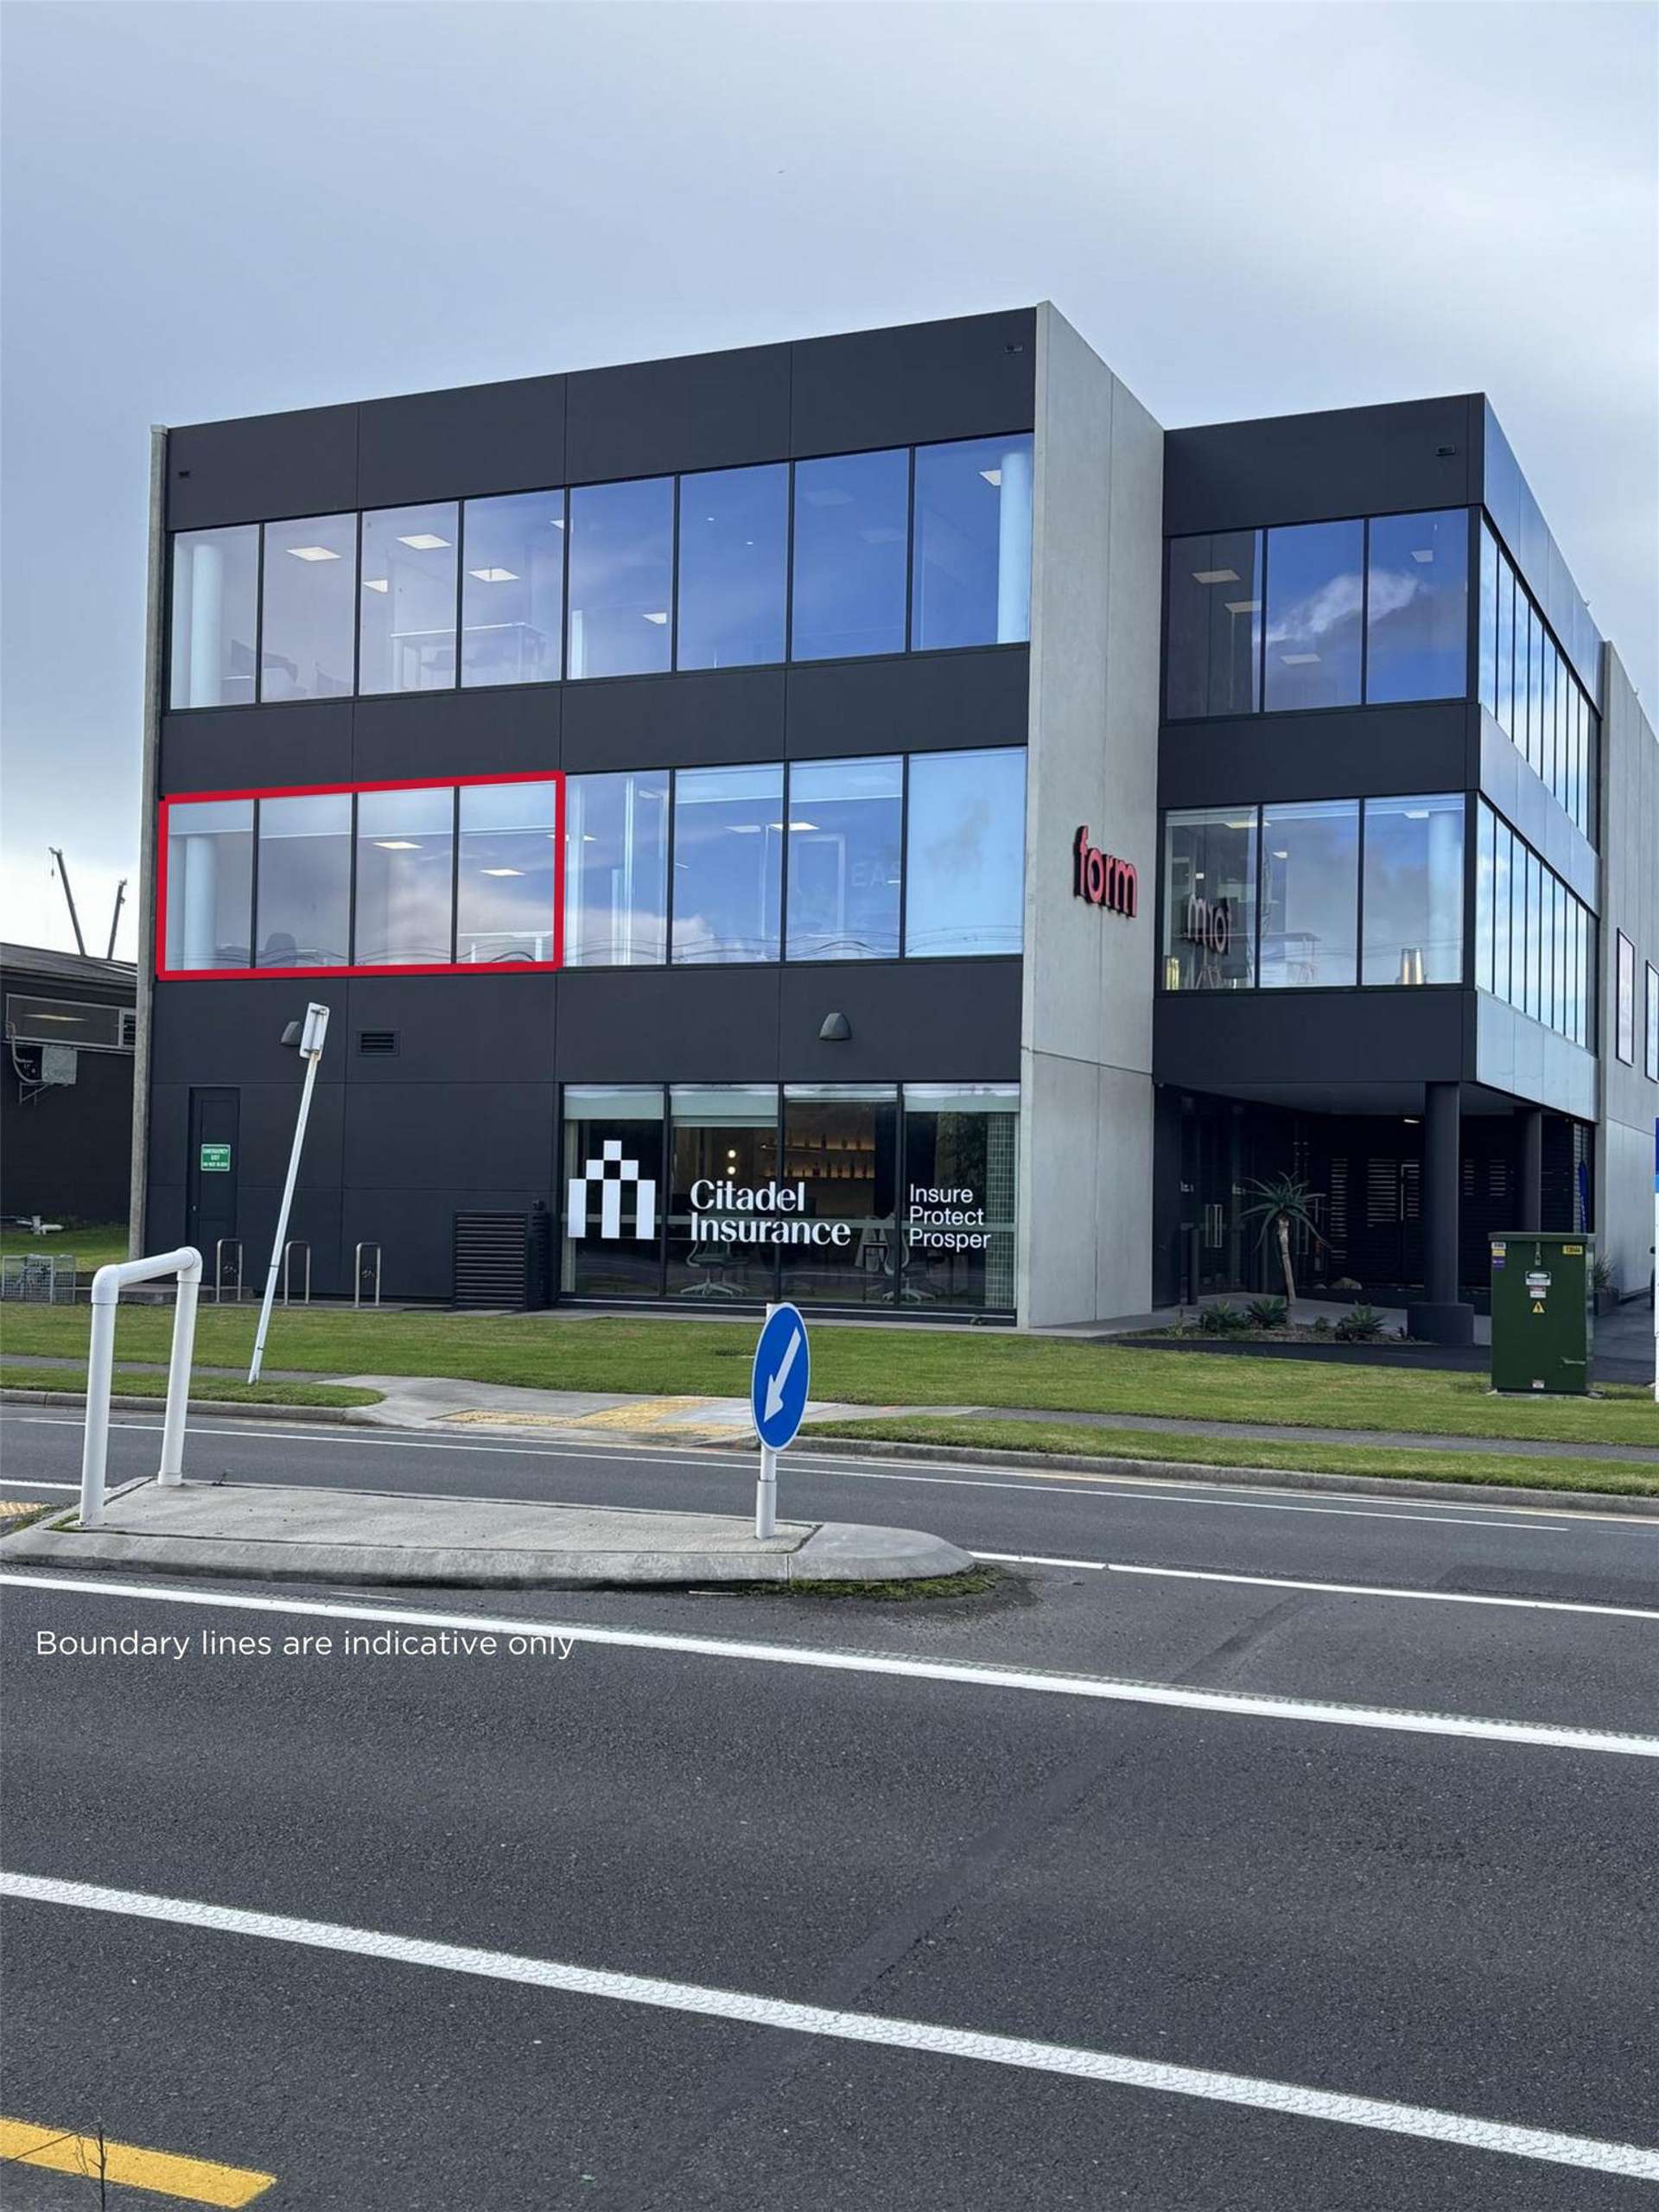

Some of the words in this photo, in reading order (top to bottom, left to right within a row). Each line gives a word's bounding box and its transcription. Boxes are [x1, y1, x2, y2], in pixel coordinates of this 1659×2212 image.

[1076, 825, 1137, 918] form
[690, 1179, 805, 1211] Citadel
[910, 1184, 973, 1204] Insure
[690, 1211, 851, 1246] Insurance
[910, 1205, 984, 1226] Protect
[910, 1228, 991, 1253] Prosper
